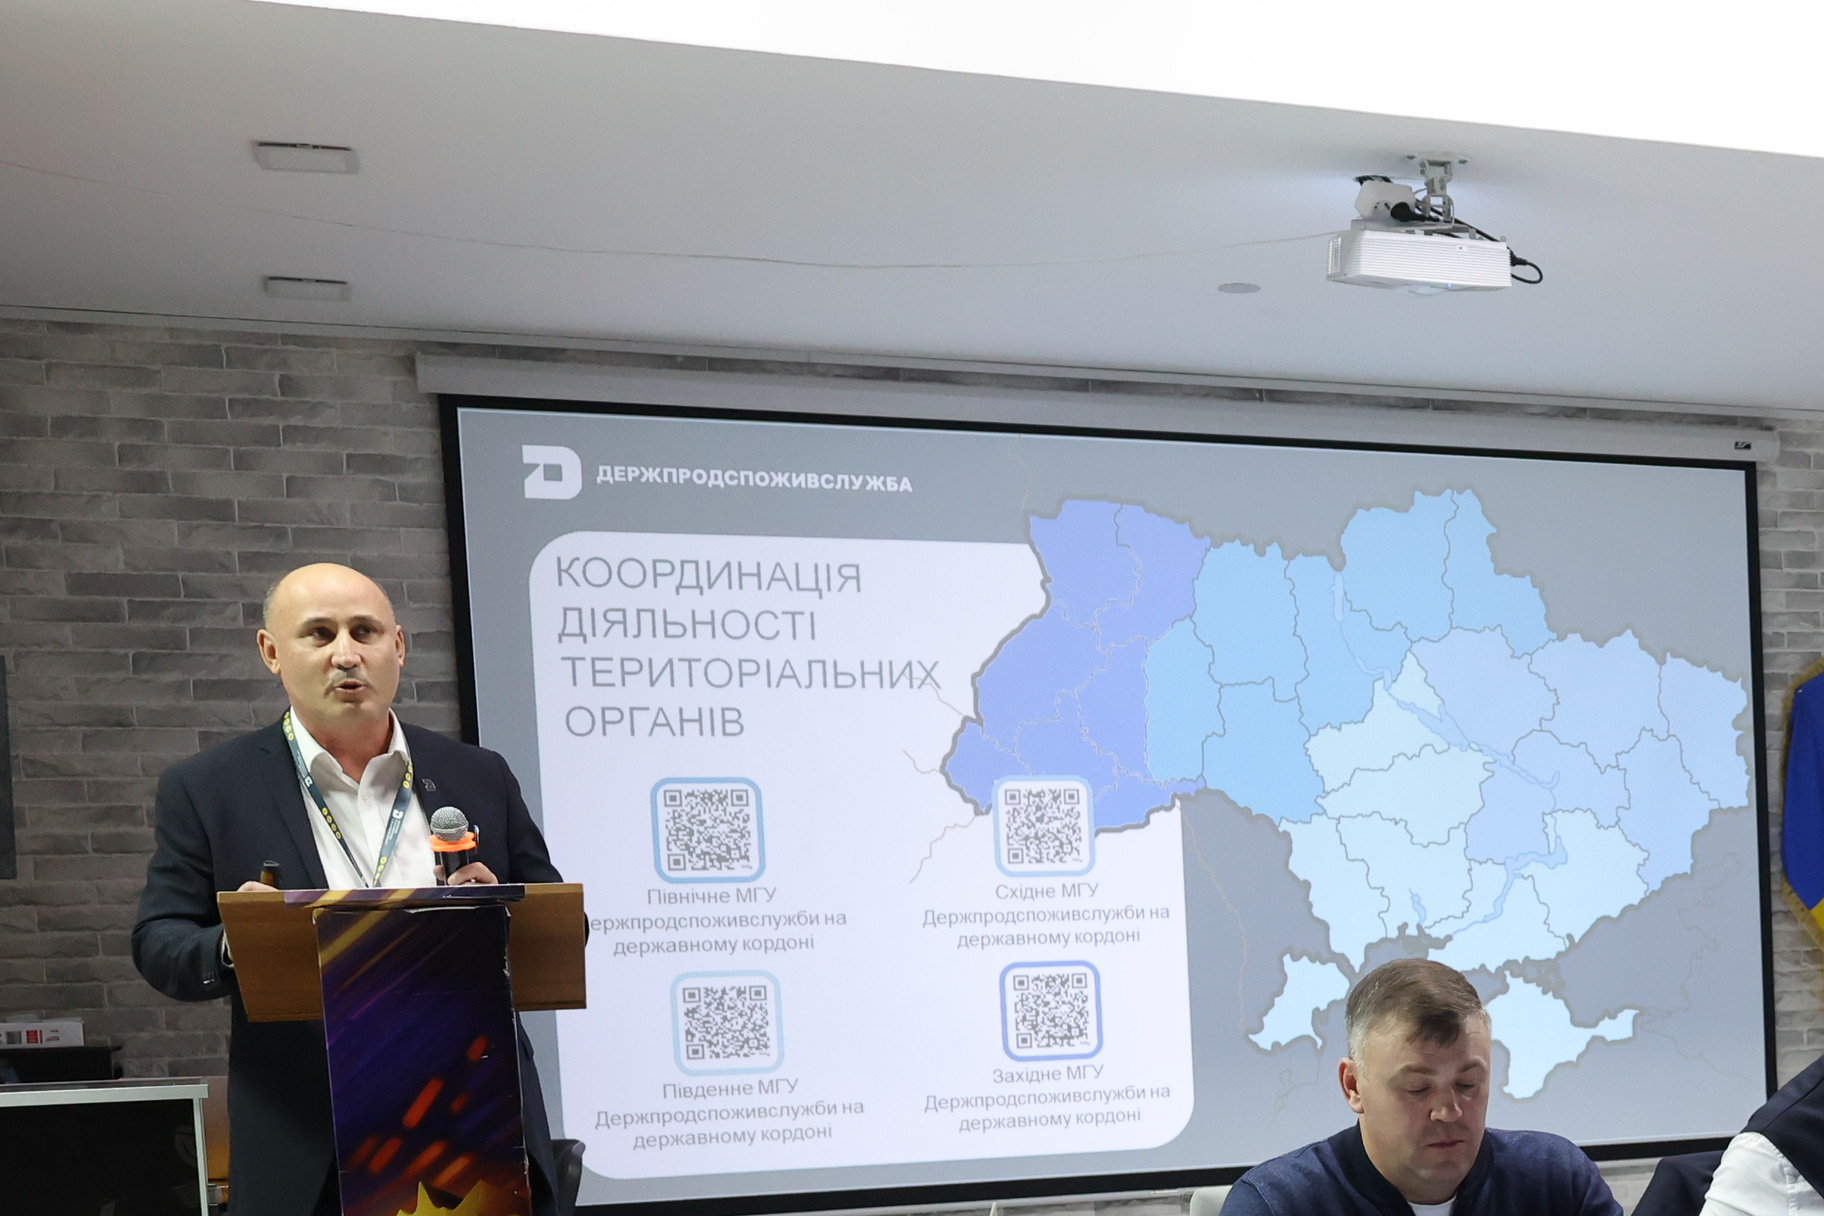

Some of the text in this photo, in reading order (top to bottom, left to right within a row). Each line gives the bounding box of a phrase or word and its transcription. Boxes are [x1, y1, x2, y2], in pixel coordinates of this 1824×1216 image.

[596, 465, 913, 493] ДЕРЖПРОДСПОЖИВСЛУЖБА
[556, 556, 861, 598] КООРДИНАЦІЯ
[558, 607, 816, 645] ДІЯЛЬНОСТІ
[560, 656, 942, 690] ТЕРИТОРІАЛЬНИХ
[566, 706, 745, 738] ОРГАНІВ
[648, 887, 777, 905] Північне МГУ
[996, 882, 1099, 901] Східне МГУ
[590, 912, 848, 935] ержпродспоживслужби на
[923, 906, 1171, 928] Держпродспоживслужби на
[613, 936, 814, 958] державному кордоні
[958, 931, 1141, 950] державному кордоні
[993, 1064, 1104, 1084] Західне МГУ
[663, 1078, 800, 1100] Південне МГУ
[925, 1087, 1171, 1114] Держпродспоживслужби на
[595, 1101, 865, 1130] Держпродспоживслужби на
[959, 1109, 1141, 1133] державному кордоні
[633, 1127, 832, 1151] державному кордоні
